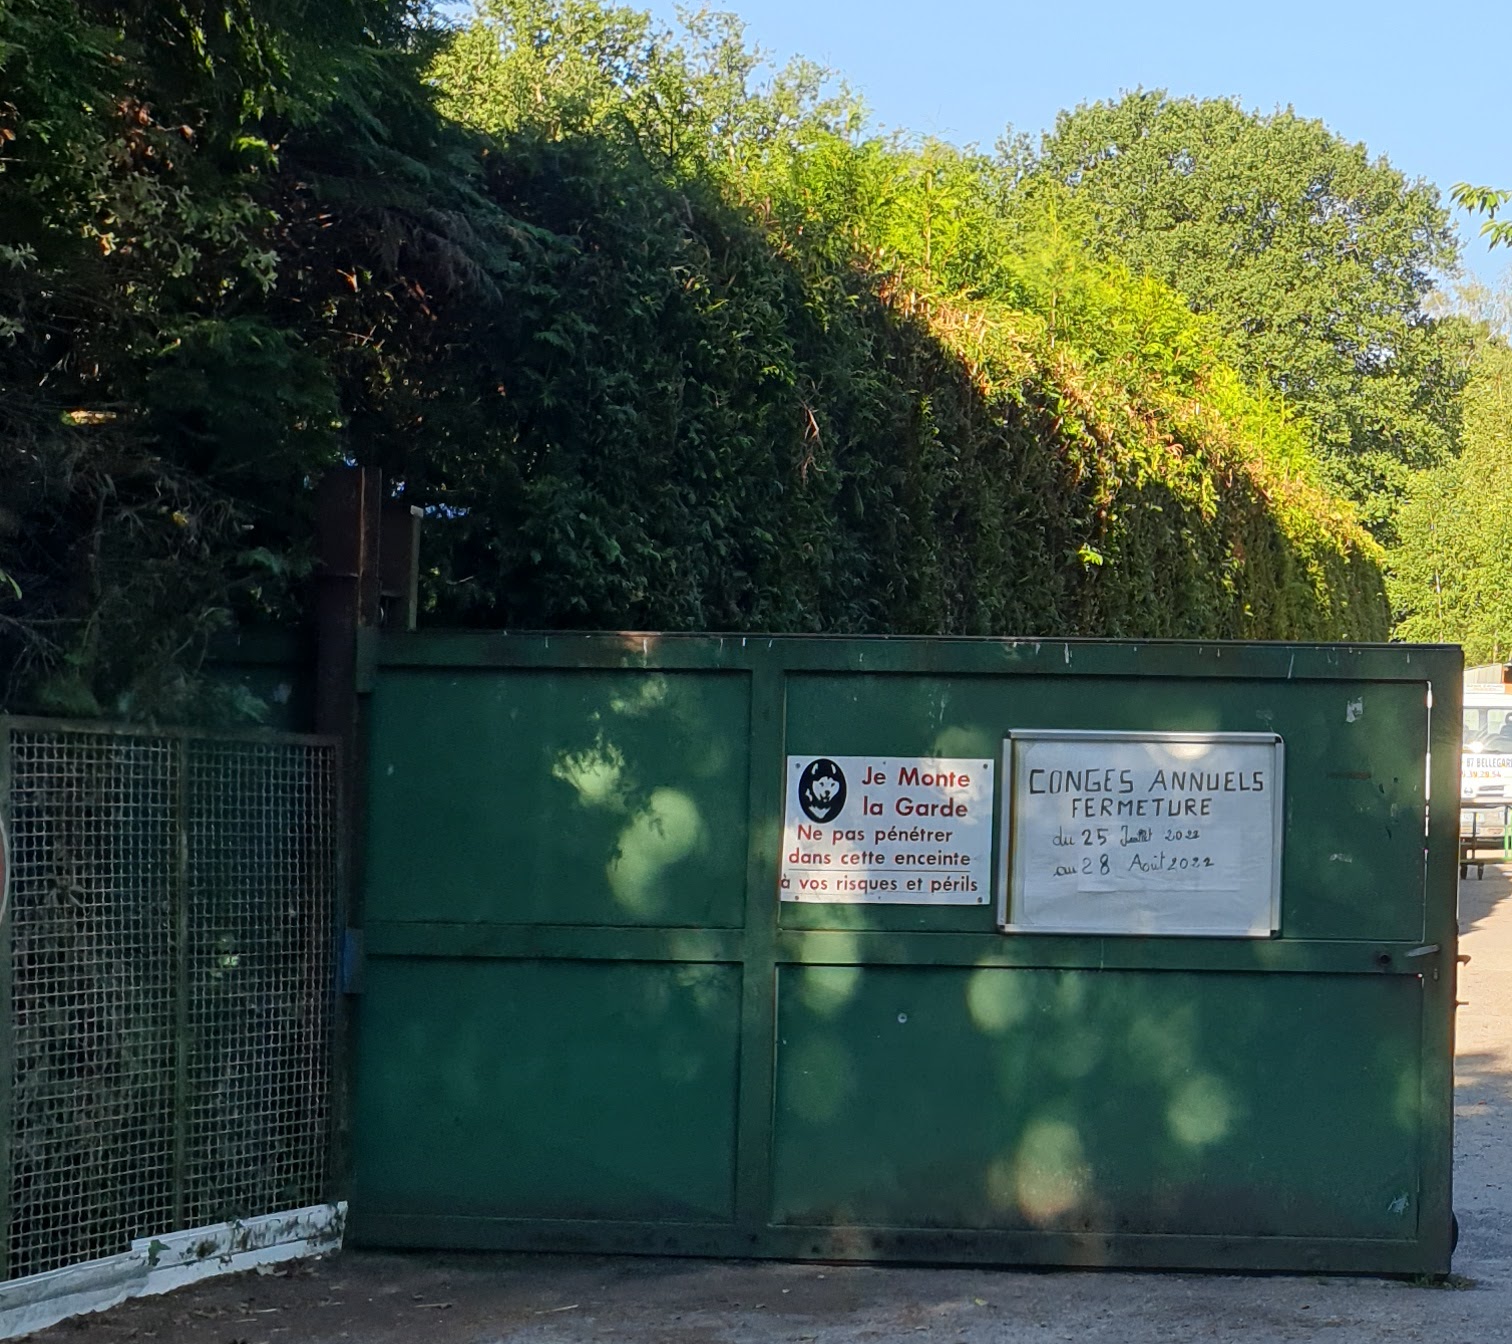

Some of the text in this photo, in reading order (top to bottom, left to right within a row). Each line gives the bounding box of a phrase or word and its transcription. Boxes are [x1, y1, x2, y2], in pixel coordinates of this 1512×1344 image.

[862, 766, 971, 787] Je Monte
[1029, 768, 1264, 794] CONGES ANNUELS
[863, 795, 969, 817] la Garde
[1072, 797, 1213, 818] FERMETURE
[797, 824, 953, 845] Ne pas pénétrer
[1053, 825, 1076, 846] du
[1081, 828, 1109, 846] 25
[788, 847, 971, 866] dans cette enceinte
[1053, 864, 1077, 877] au
[1082, 853, 1110, 876] 28
[1167, 856, 1215, 871] 2022
[780, 874, 979, 893] à vos risques et périls
